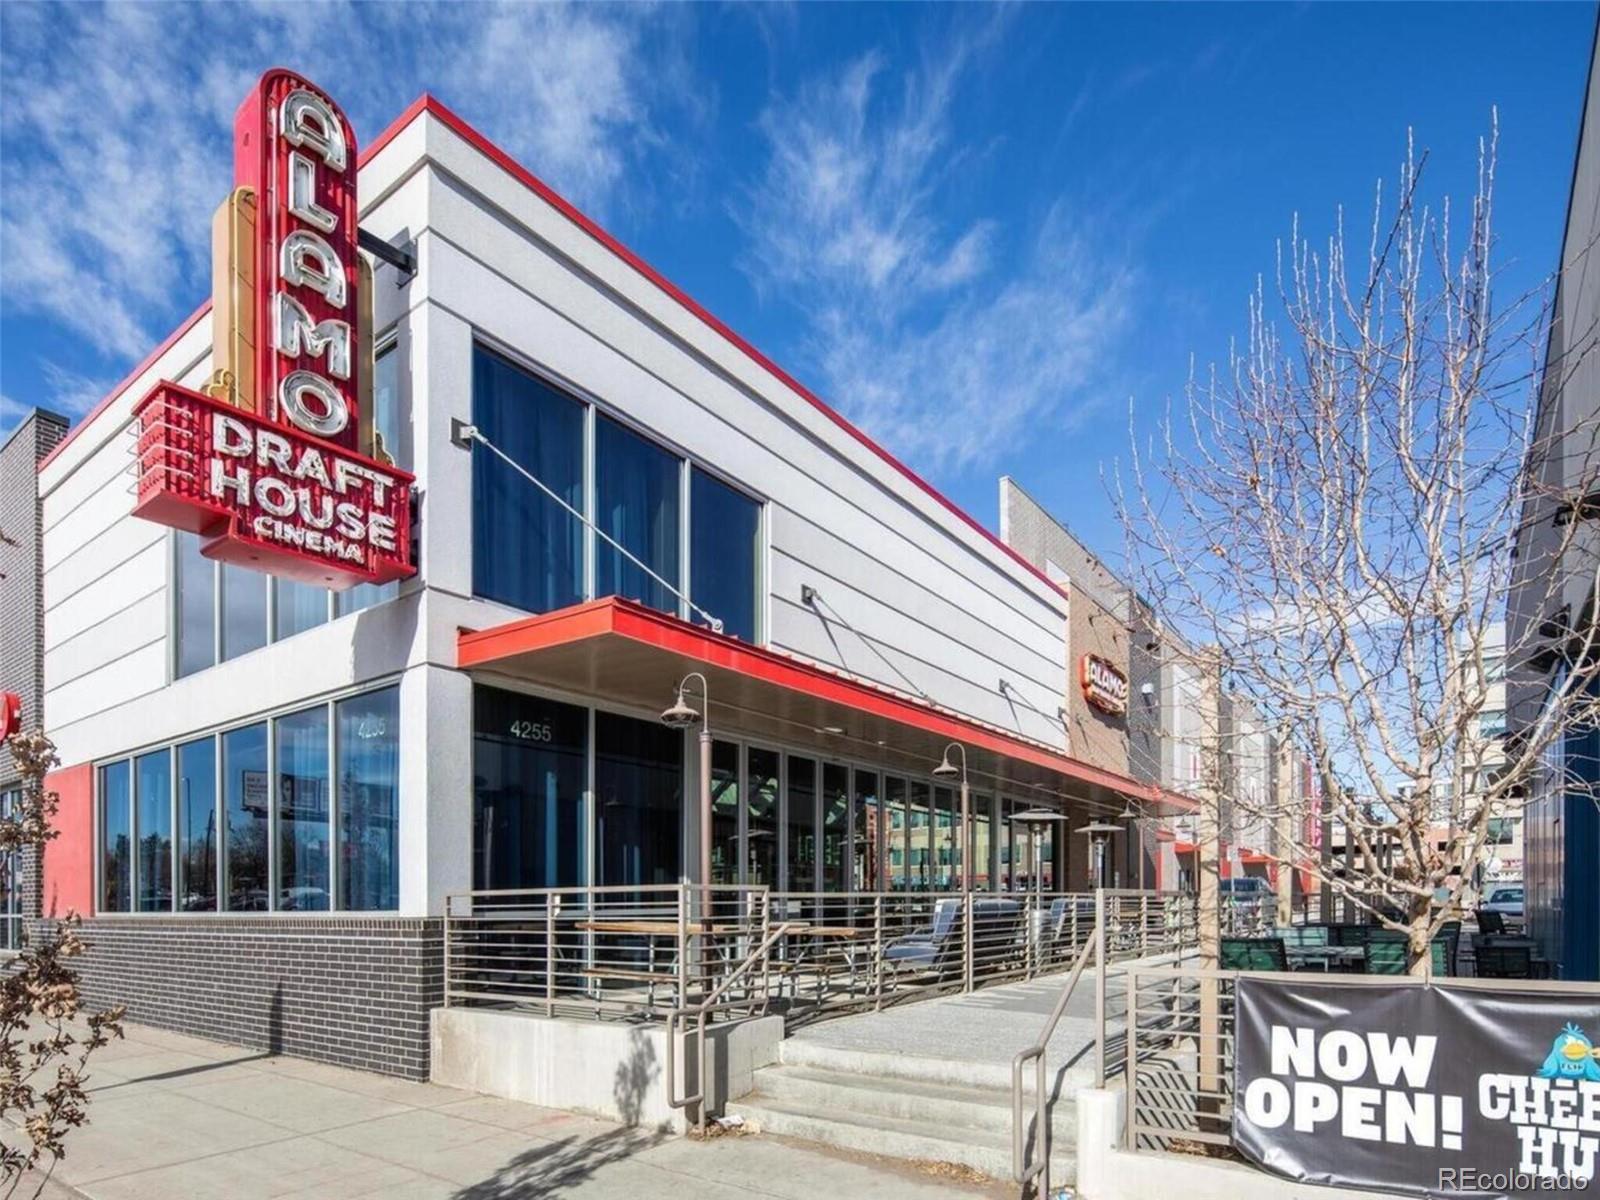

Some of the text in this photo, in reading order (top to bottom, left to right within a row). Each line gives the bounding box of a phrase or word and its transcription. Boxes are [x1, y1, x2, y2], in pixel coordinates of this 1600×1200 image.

[275, 90, 351, 437] ALAMO
[213, 412, 394, 508] DRAFT
[211, 458, 396, 551] HOUSE
[254, 516, 365, 564] CINEMA
[510, 720, 552, 742] 4255
[1270, 1025, 1437, 1088] NOW
[1245, 1077, 1463, 1150] OPEN!
